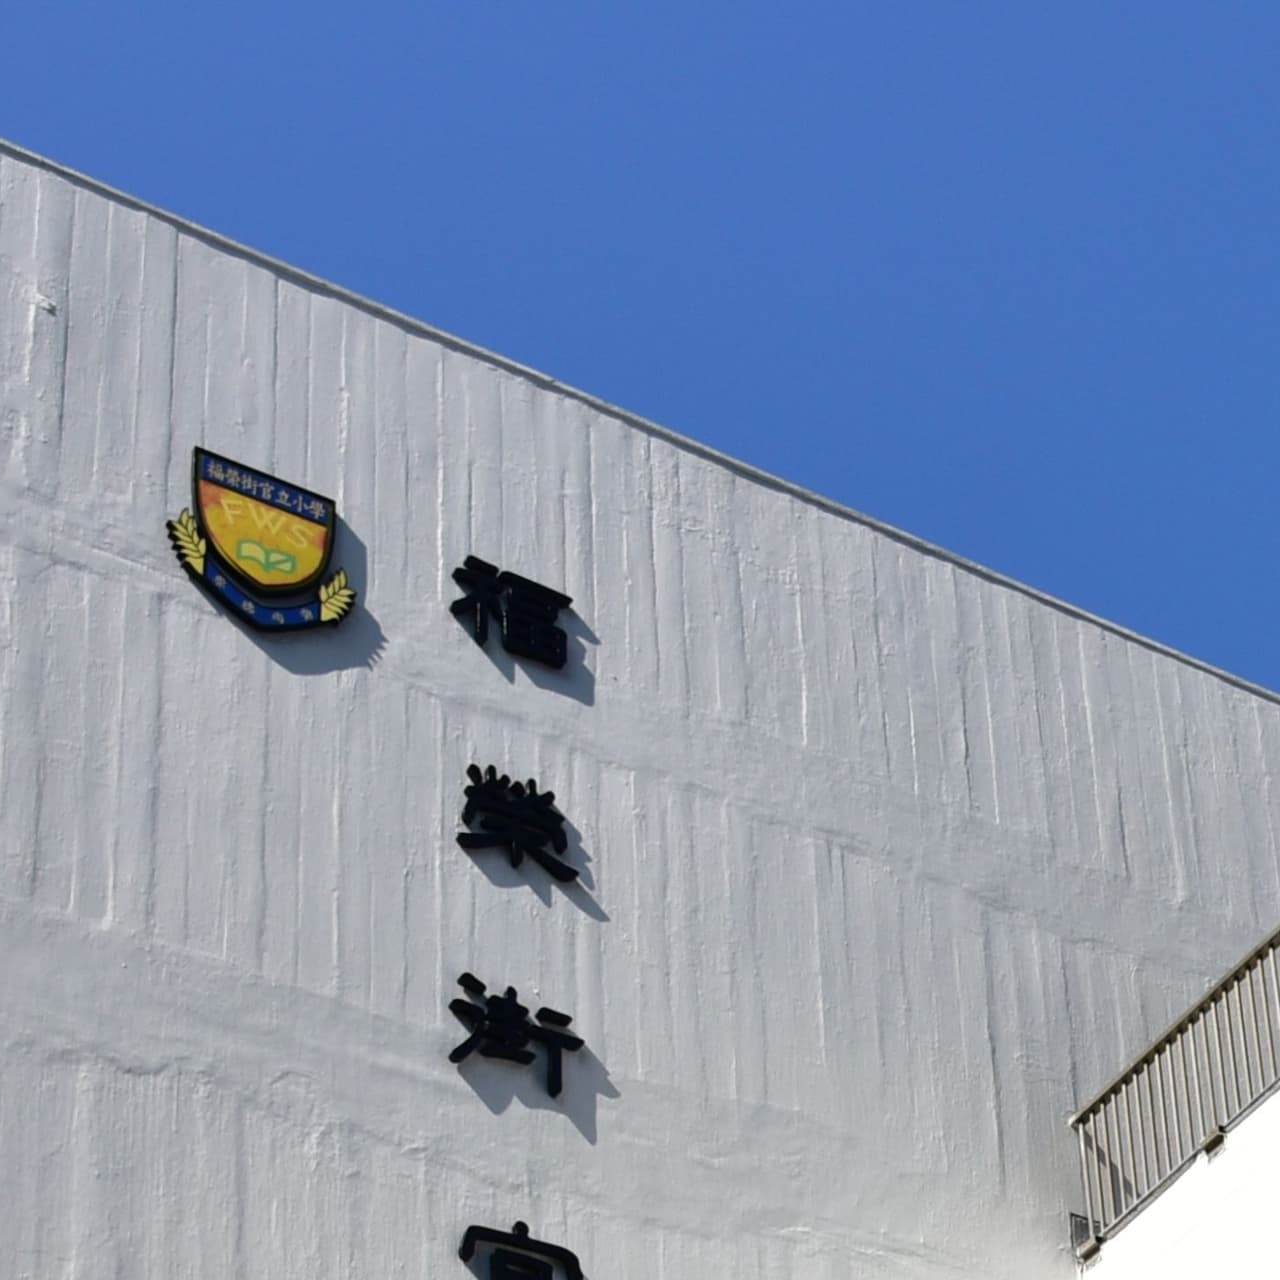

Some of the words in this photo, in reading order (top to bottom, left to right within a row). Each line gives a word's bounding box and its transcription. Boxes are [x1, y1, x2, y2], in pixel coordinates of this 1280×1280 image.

[207, 460, 326, 519] 福榮街官立小學
[219, 498, 315, 548] FWS
